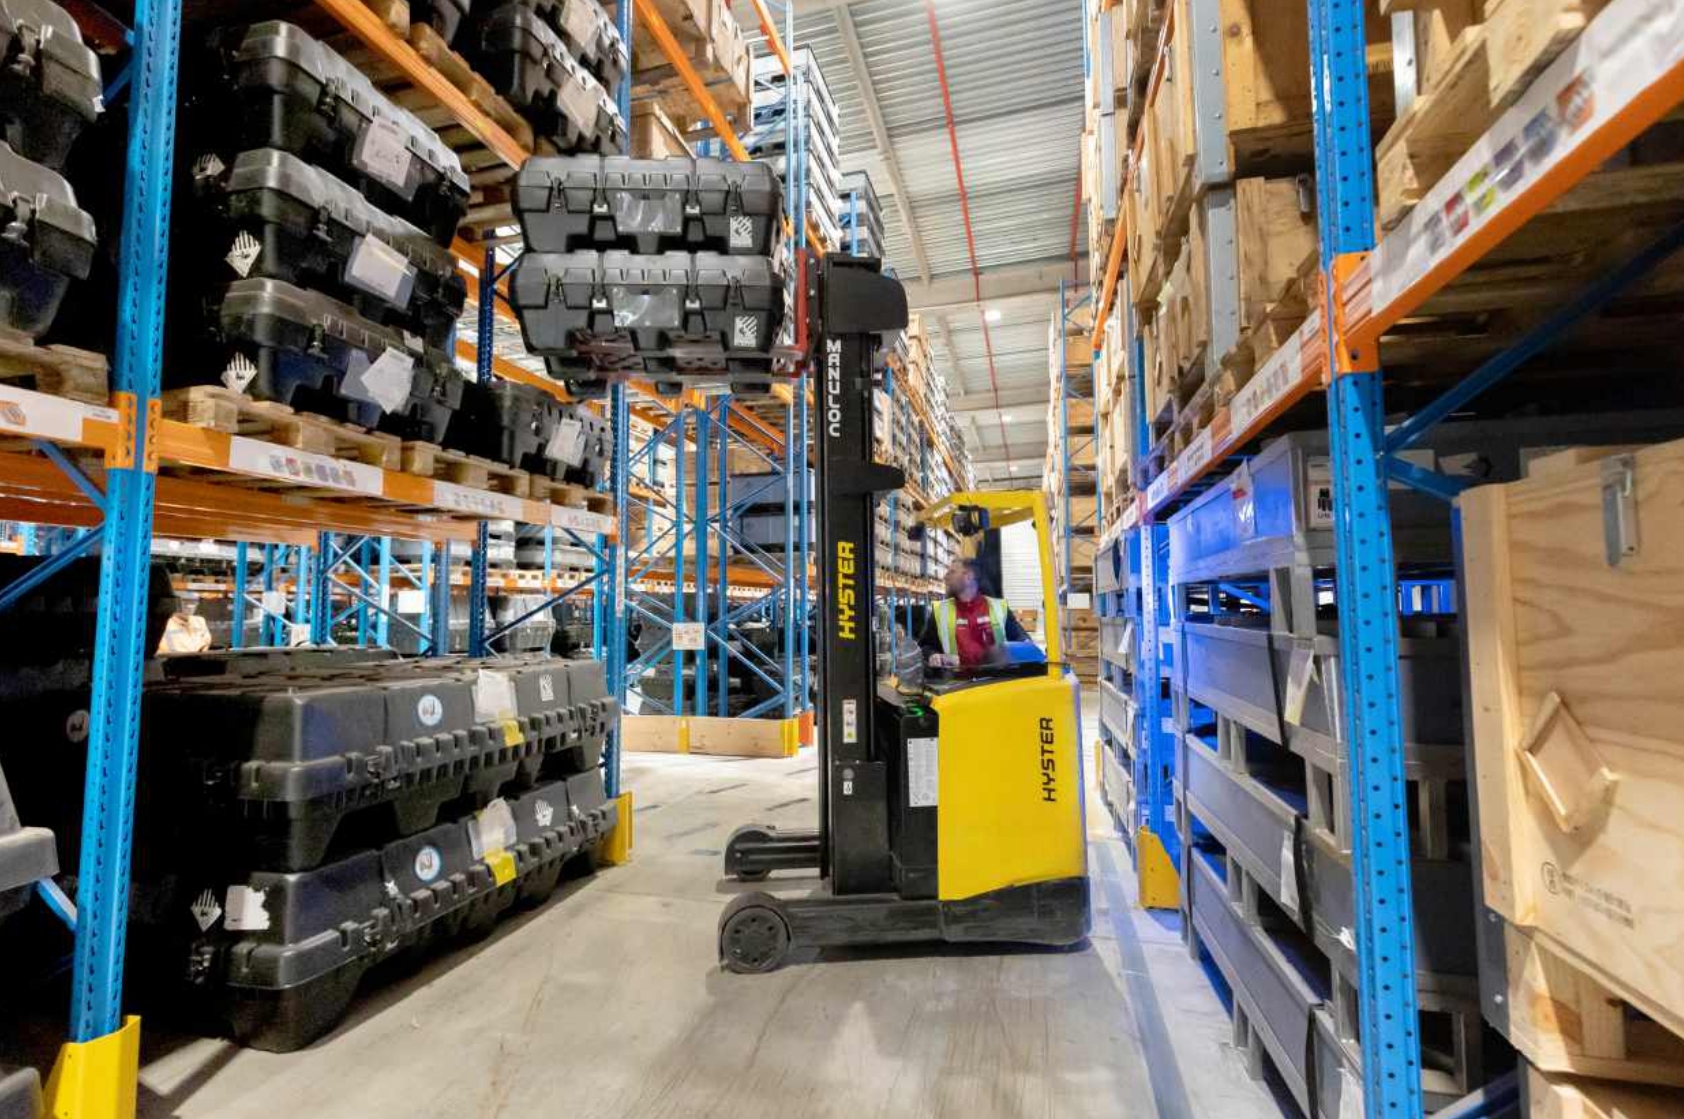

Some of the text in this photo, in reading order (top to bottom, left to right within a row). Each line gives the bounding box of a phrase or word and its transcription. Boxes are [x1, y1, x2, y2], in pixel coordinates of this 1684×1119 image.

[827, 339, 841, 437] MANULOC
[838, 541, 855, 639] HYSTER
[1040, 717, 1056, 802] HYSTER
